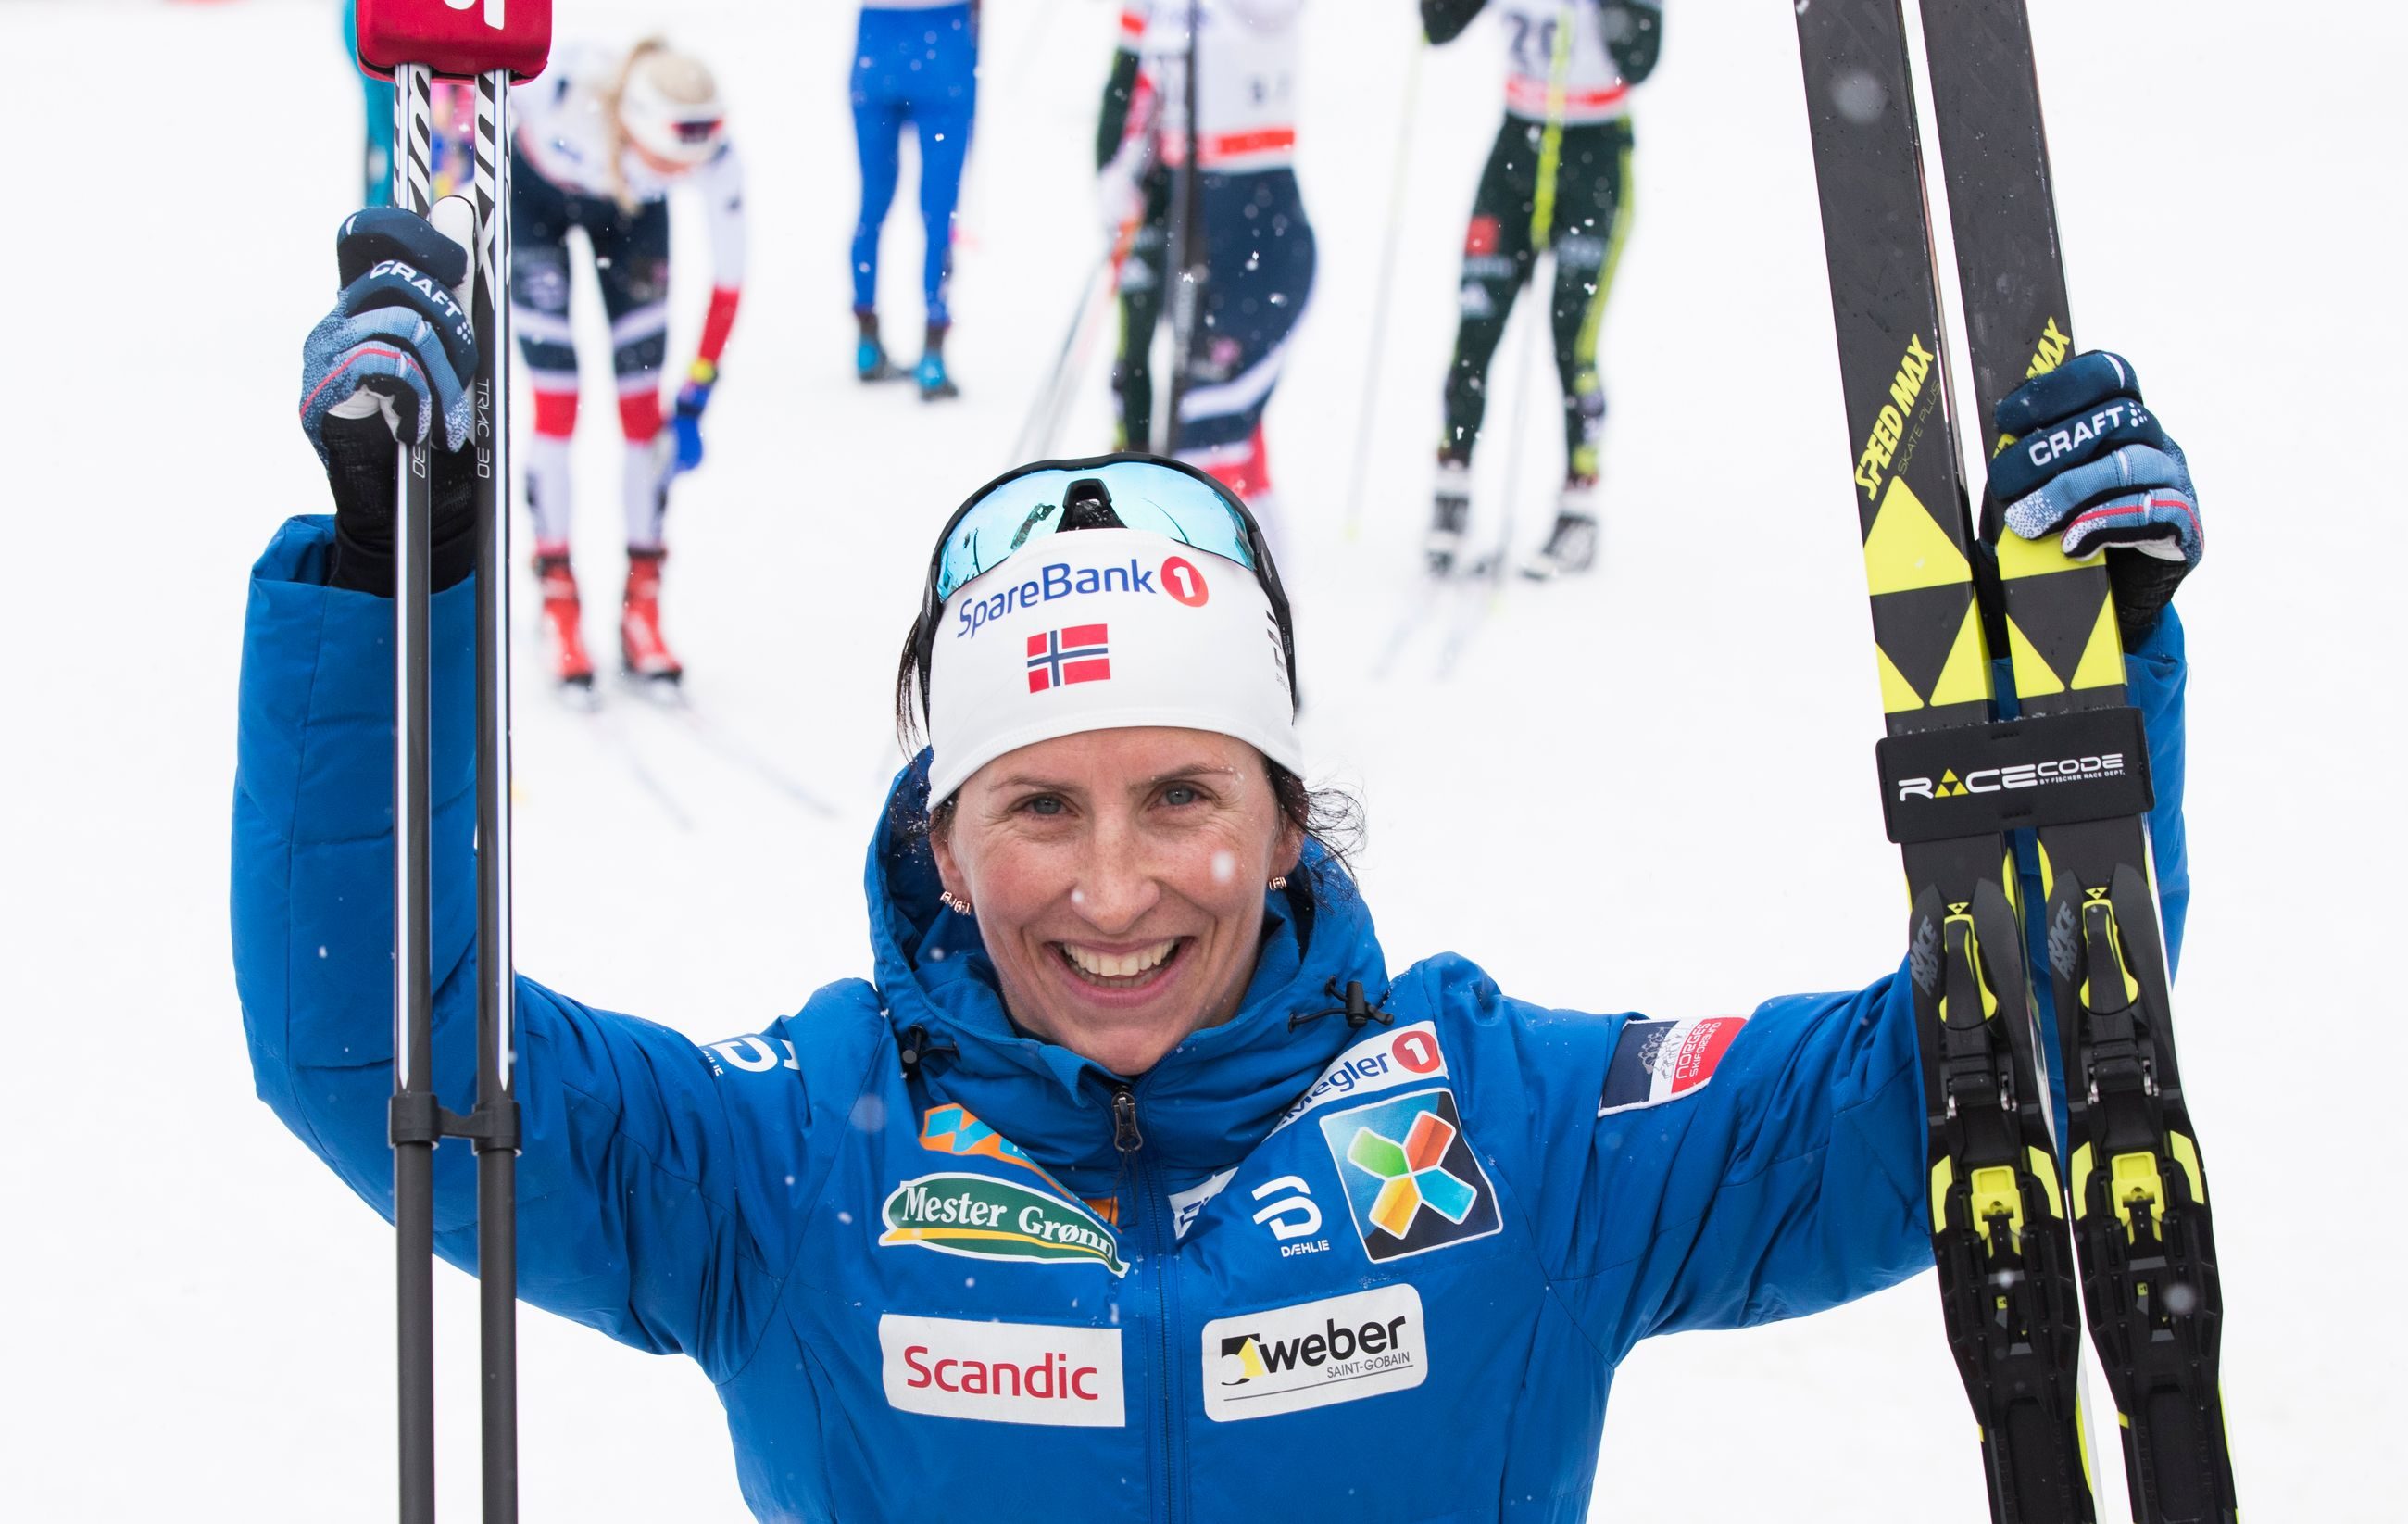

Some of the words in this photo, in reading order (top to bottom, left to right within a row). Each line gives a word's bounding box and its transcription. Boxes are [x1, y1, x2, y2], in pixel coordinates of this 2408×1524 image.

[370, 260, 462, 317] CRAFT
[476, 378, 490, 438] TRIAC
[1855, 397, 1903, 501] SPEED
[1889, 333, 1934, 417] MAX
[1897, 422, 1924, 475] SKATE
[1918, 379, 1941, 424] PLUS
[2028, 406, 2124, 466] CRAFT
[412, 445, 426, 479] 30
[476, 447, 490, 479] 30
[956, 559, 1158, 639] SpareBank
[2039, 777, 2051, 786] BY
[2051, 773, 2082, 784] FISCHER
[2083, 771, 2103, 780] RACE
[1676, 1022, 1711, 1079] NORGES
[1689, 1021, 1722, 1077] SKIFORBUND
[1277, 1052, 1387, 1124] Megler
[901, 1186, 1008, 1228] Mester
[1018, 1206, 1113, 1259] Grønn
[1280, 1239, 1330, 1258] DÆHLIE
[903, 1345, 1098, 1400] Scandic
[1258, 1316, 1406, 1374] weber
[1326, 1352, 1411, 1379] SAINT-GOBAIN
